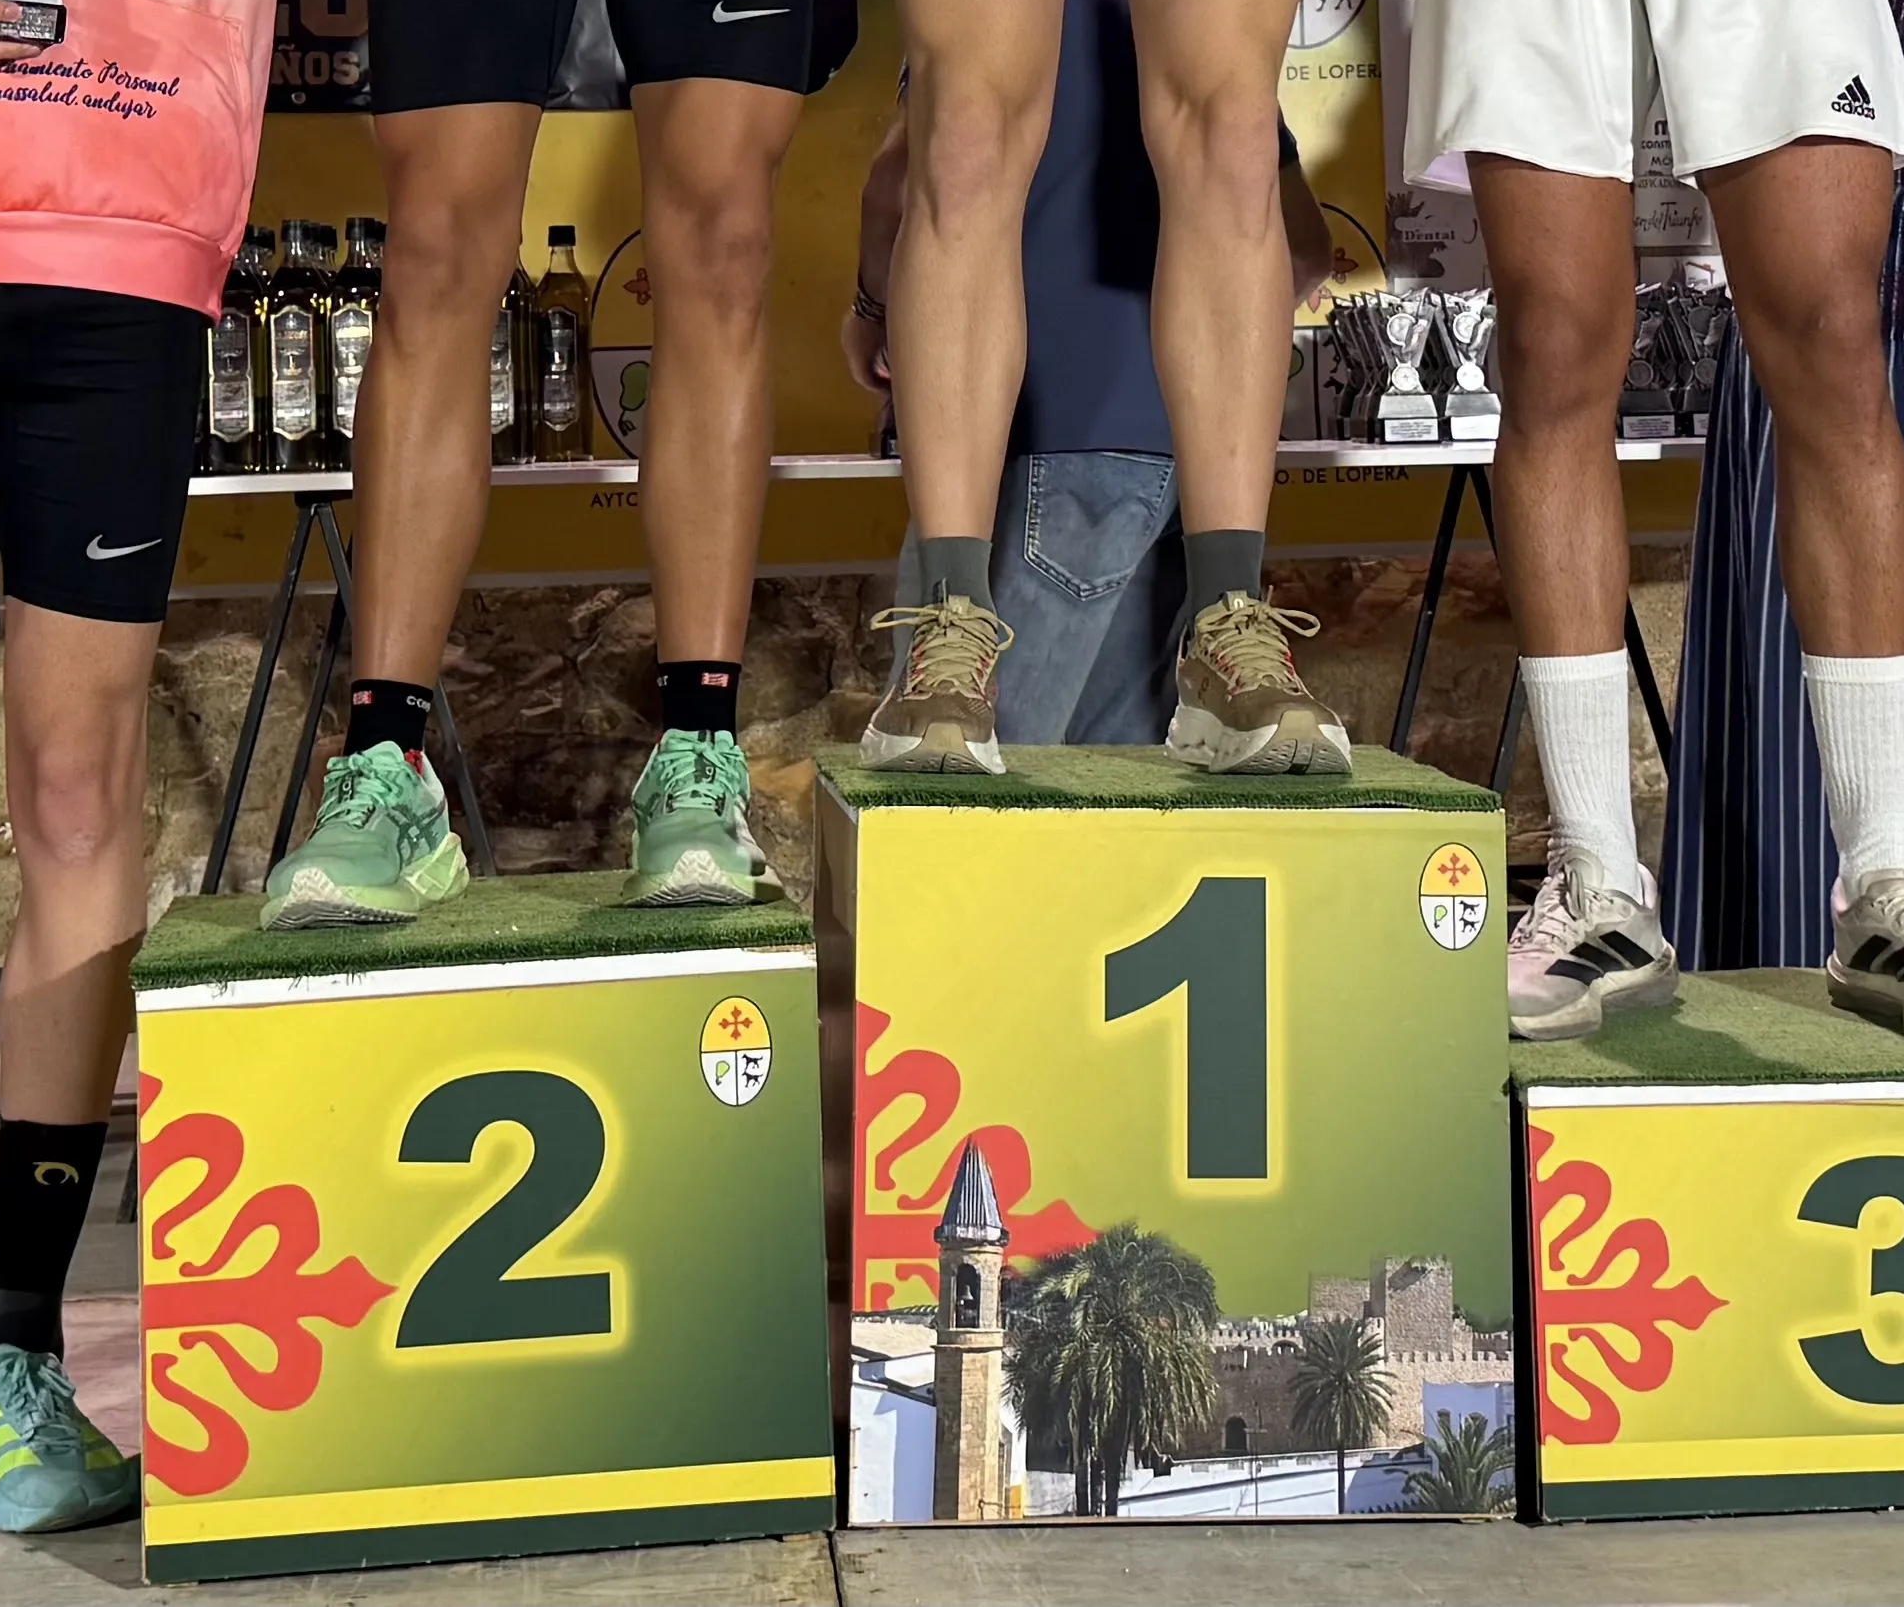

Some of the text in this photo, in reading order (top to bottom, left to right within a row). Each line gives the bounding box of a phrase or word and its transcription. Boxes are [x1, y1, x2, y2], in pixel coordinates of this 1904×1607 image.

[98, 59, 180, 96] Personal
[272, 43, 360, 86] ÑOS
[1286, 65, 1310, 81] DE
[1303, 468, 1327, 484] DE
[1335, 465, 1410, 483] LOPERA
[1104, 876, 1268, 1179] 1
[395, 1070, 612, 1349] 2
